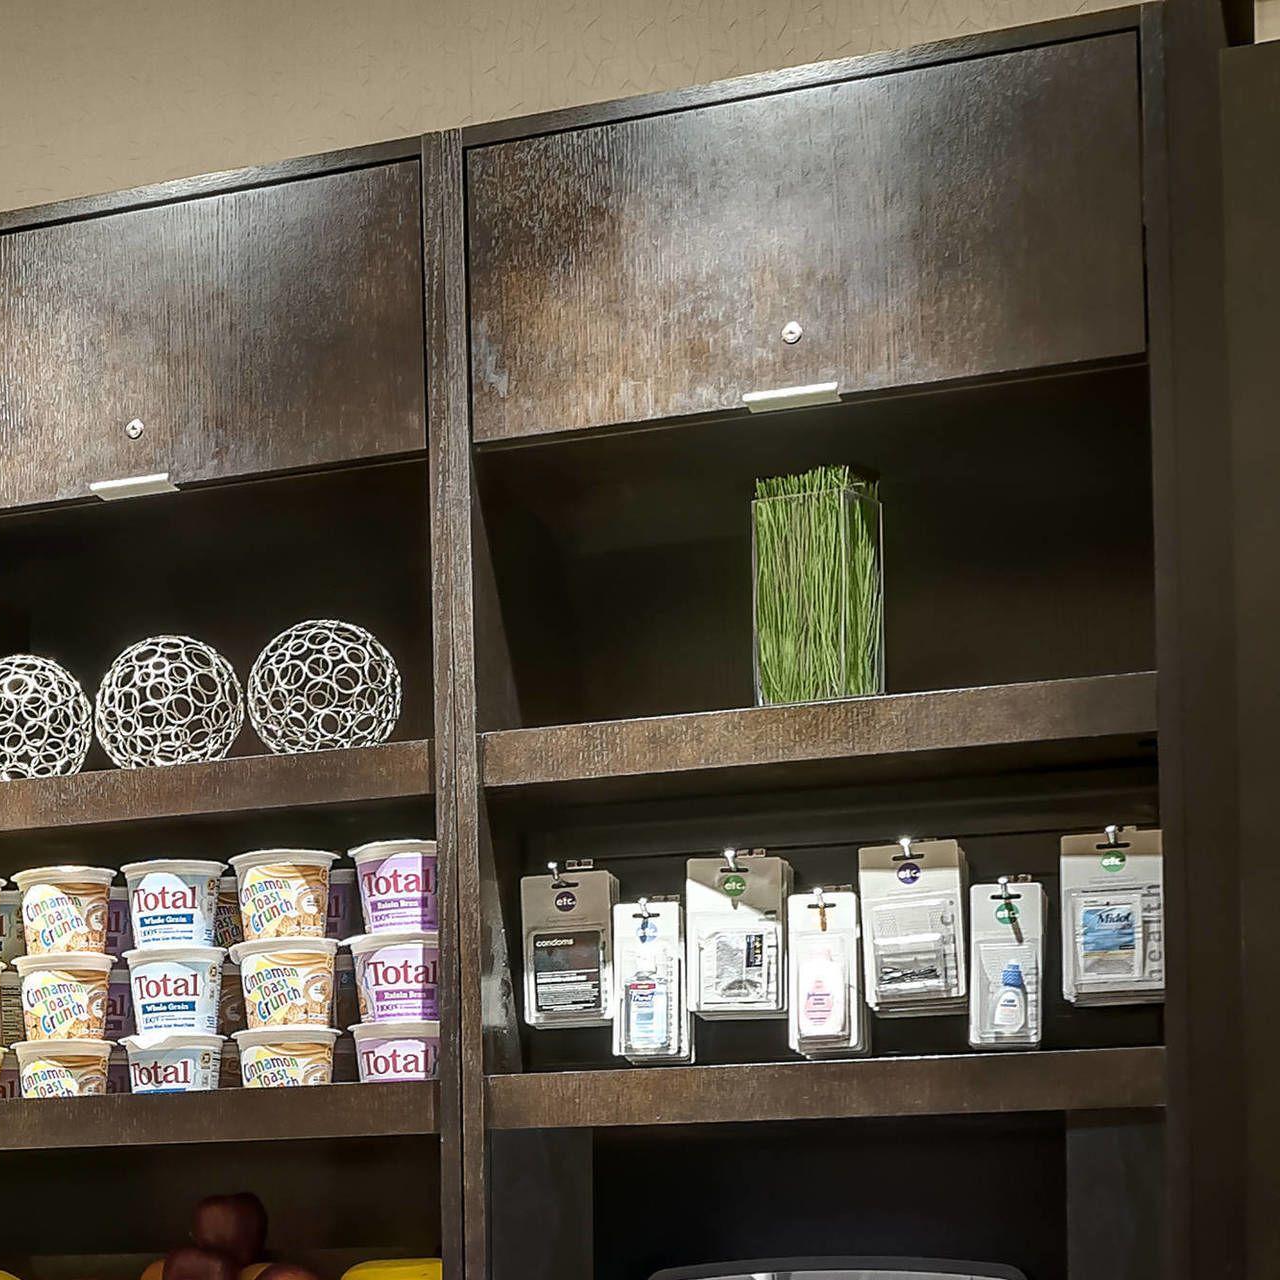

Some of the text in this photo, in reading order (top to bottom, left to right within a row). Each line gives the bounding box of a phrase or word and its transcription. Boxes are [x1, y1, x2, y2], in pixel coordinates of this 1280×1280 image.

[240, 878, 291, 907] Cinnamon
[362, 868, 432, 899] Total
[25, 895, 82, 922] Cinnamon
[132, 886, 198, 913] Total
[251, 891, 281, 912] Toast
[44, 908, 73, 929] Toast
[143, 915, 188, 926] Whole Grain
[251, 897, 295, 934] Crunch
[1096, 911, 1132, 925] Midol
[40, 914, 85, 948] Crunch
[535, 937, 575, 947] condoms
[244, 966, 299, 995] Cinnamon
[367, 959, 438, 987] Total
[26, 983, 85, 1008] Cinnamon
[135, 973, 200, 1000] Total
[258, 979, 289, 1000] Toast
[383, 991, 409, 999] Raisin
[44, 994, 73, 1014] Toast
[145, 1004, 168, 1012] Whole
[257, 985, 302, 1020] Crunch
[41, 1003, 85, 1035] Crunch
[131, 1061, 191, 1087] Total
[243, 1056, 299, 1081] Cinnamon
[362, 1048, 430, 1076] Total
[256, 1069, 288, 1087] Toast
